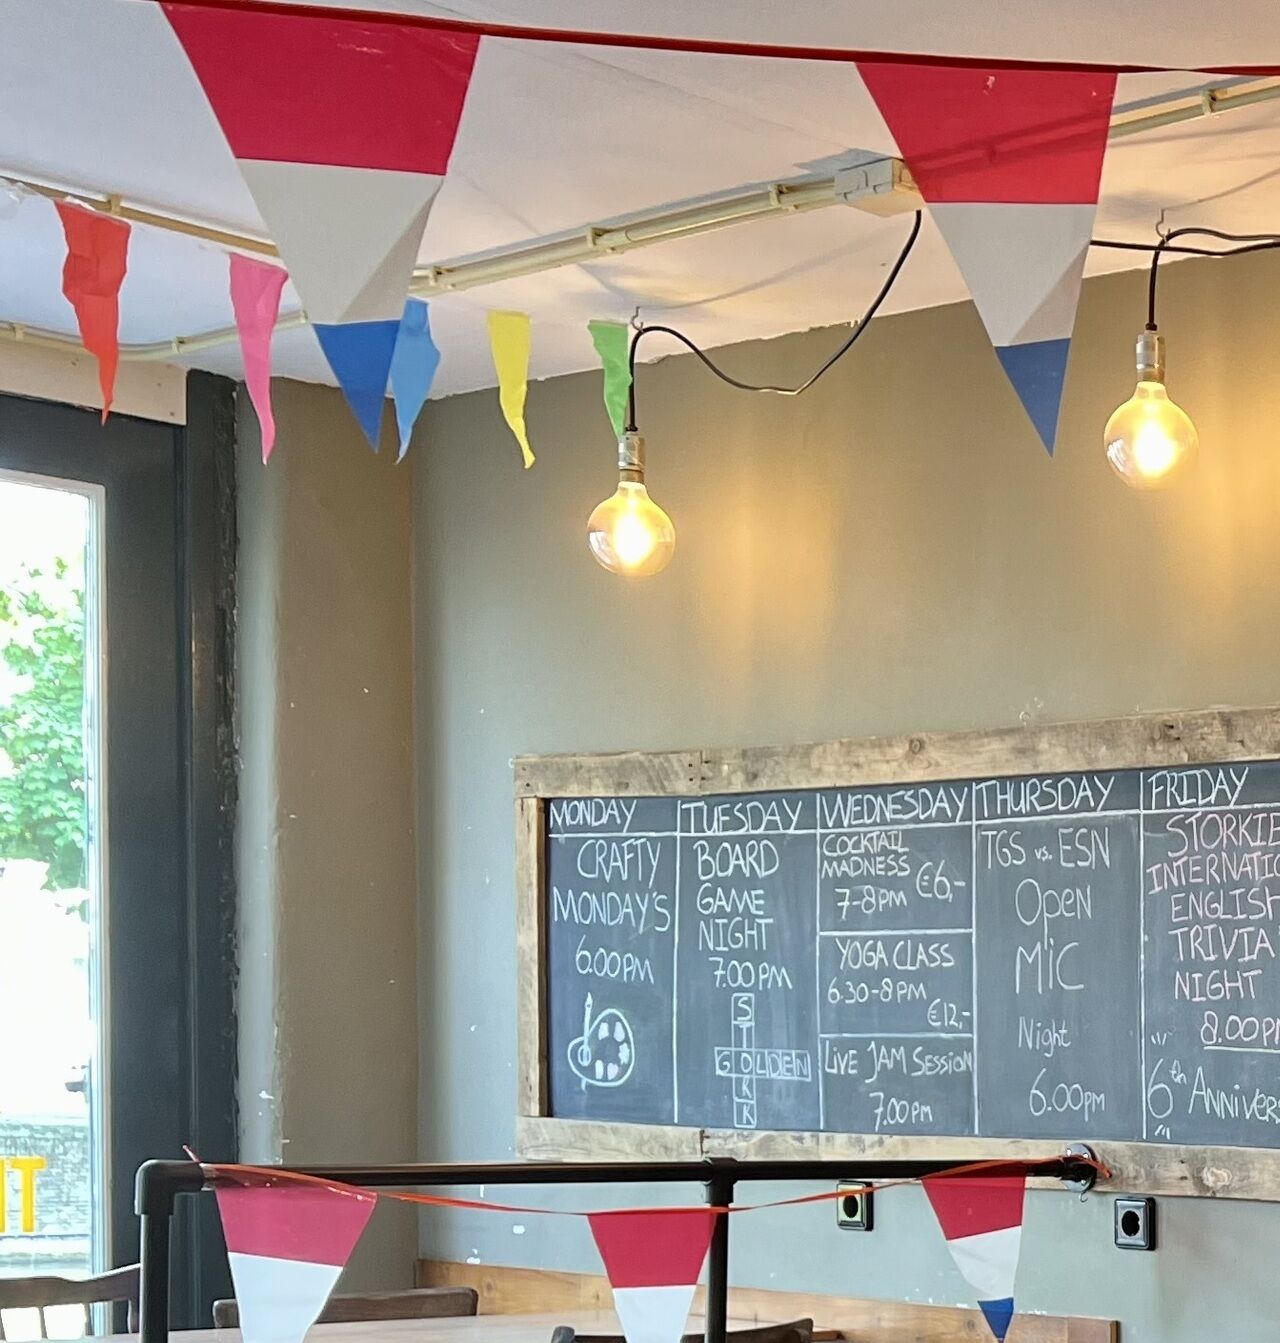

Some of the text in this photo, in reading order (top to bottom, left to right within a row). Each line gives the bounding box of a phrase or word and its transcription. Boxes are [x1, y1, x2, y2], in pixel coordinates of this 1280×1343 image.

[822, 786, 968, 828] WEDNESDAY
[976, 776, 1115, 817] THURSDAY
[1147, 767, 1249, 810] FRIDAY
[550, 799, 637, 833] MONDAY
[682, 800, 802, 834] TUESDAY
[694, 839, 780, 878] BOARD
[823, 830, 910, 857] COCKTAIL
[981, 829, 1026, 870] TGS
[1059, 827, 1111, 870] ESN
[577, 838, 661, 889] CRAFTY
[822, 854, 911, 879] MADNESS
[553, 886, 670, 935] MONDAY'S
[697, 883, 766, 916] GAME
[699, 918, 773, 951] NIGHT
[836, 937, 955, 970] YOGA CLASS
[1174, 970, 1263, 1002] NIGHT
[1018, 1017, 1072, 1057] Night
[718, 1052, 808, 1077] GOLDEN
[865, 1041, 907, 1083] JAM
[1148, 1059, 1187, 1119] 6th
